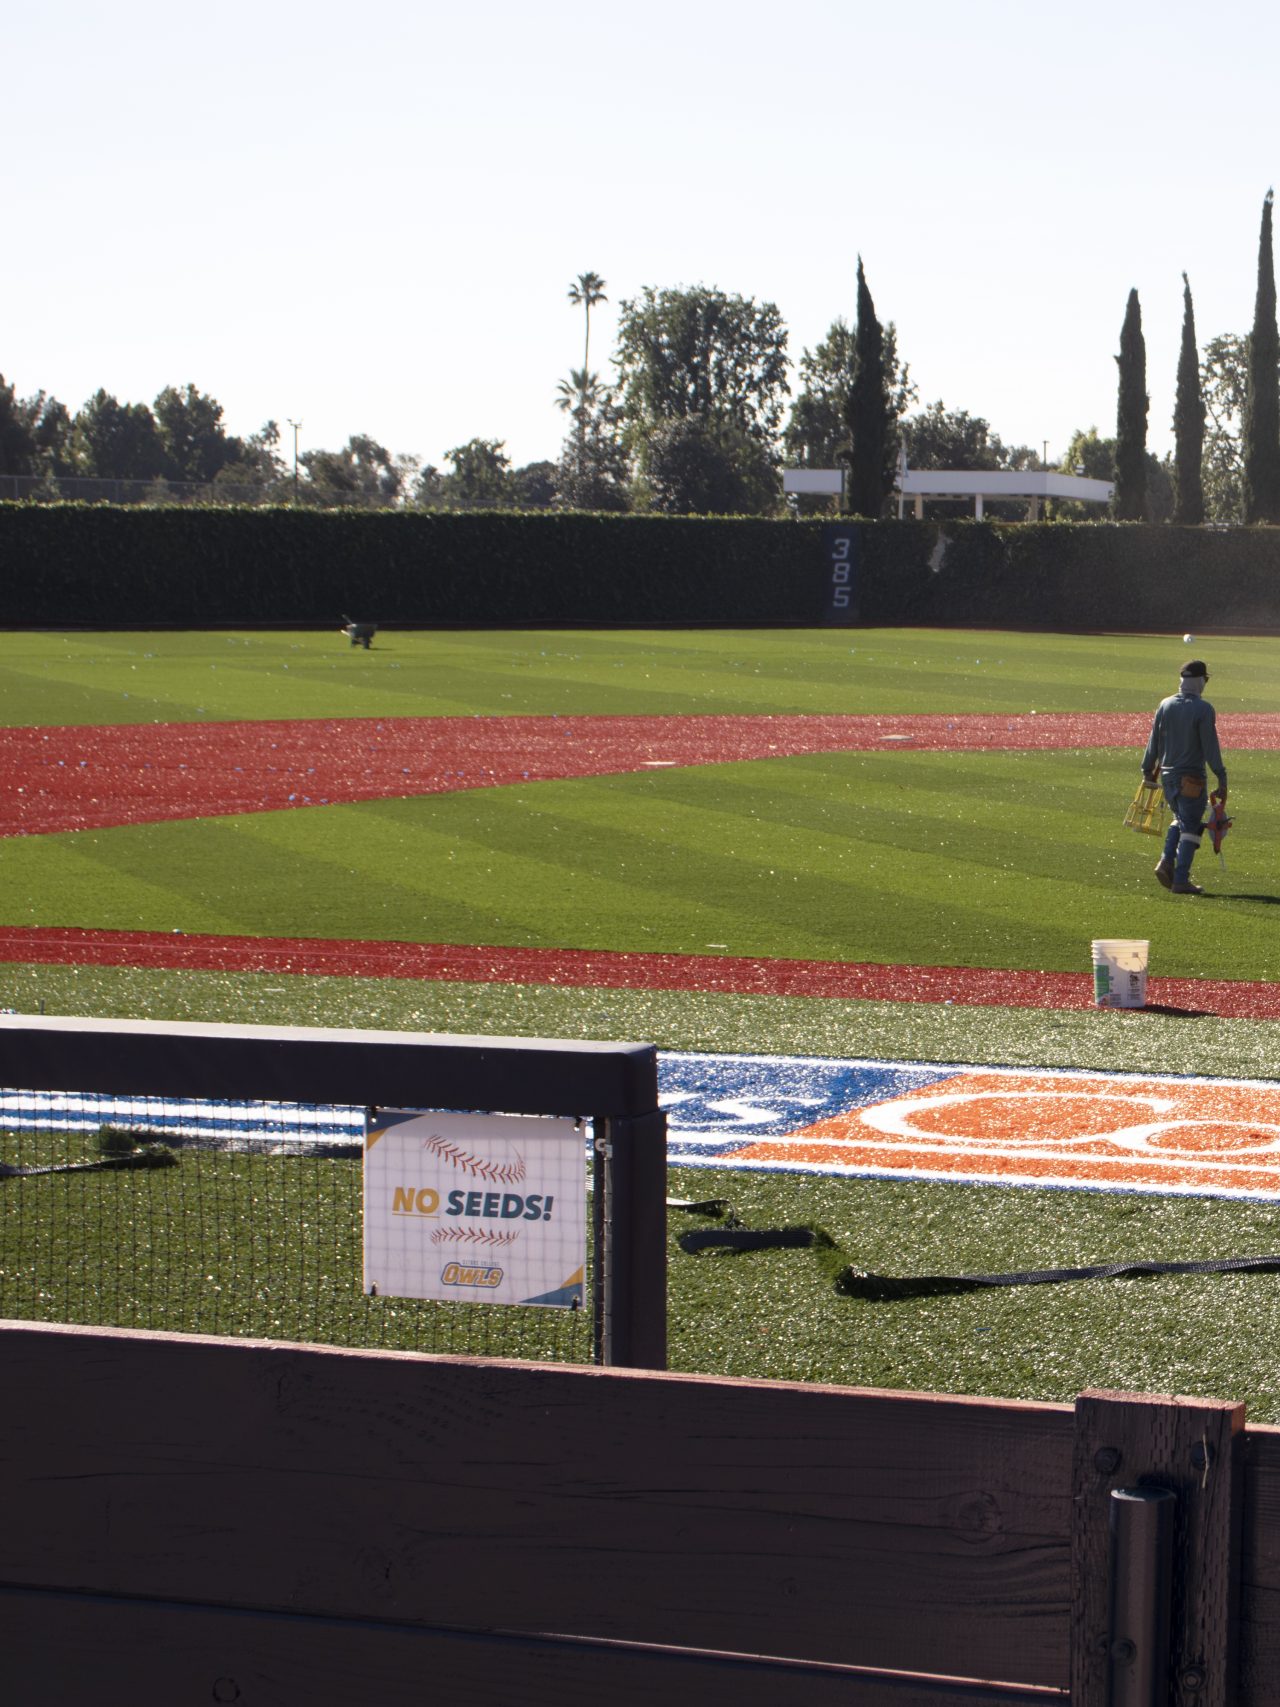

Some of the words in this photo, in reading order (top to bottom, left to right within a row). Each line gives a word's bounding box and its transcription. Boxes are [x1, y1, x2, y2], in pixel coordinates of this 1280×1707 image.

[832, 538, 851, 608] 385
[392, 1187, 440, 1214] NO
[445, 1190, 554, 1222] SEEDS!
[443, 1264, 502, 1287] OWLS
